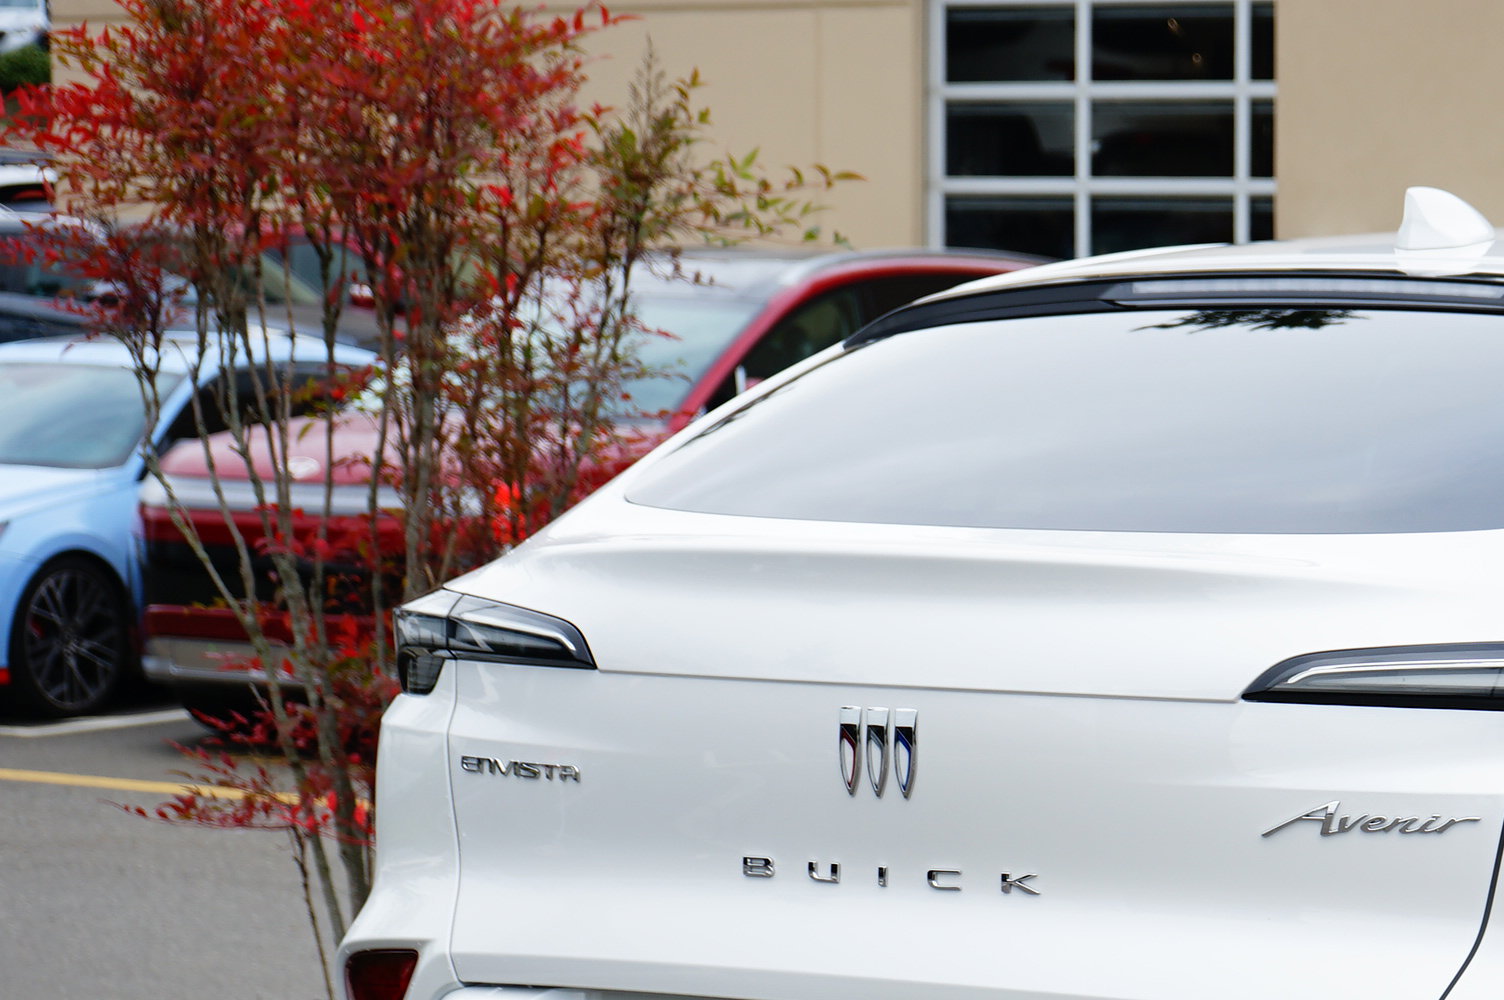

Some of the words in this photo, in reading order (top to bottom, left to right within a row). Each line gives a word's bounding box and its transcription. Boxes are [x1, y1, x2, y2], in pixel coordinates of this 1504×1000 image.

[461, 755, 581, 783] ENVISTA
[1261, 799, 1482, 839] Avenir
[741, 855, 1042, 896] BUICK
